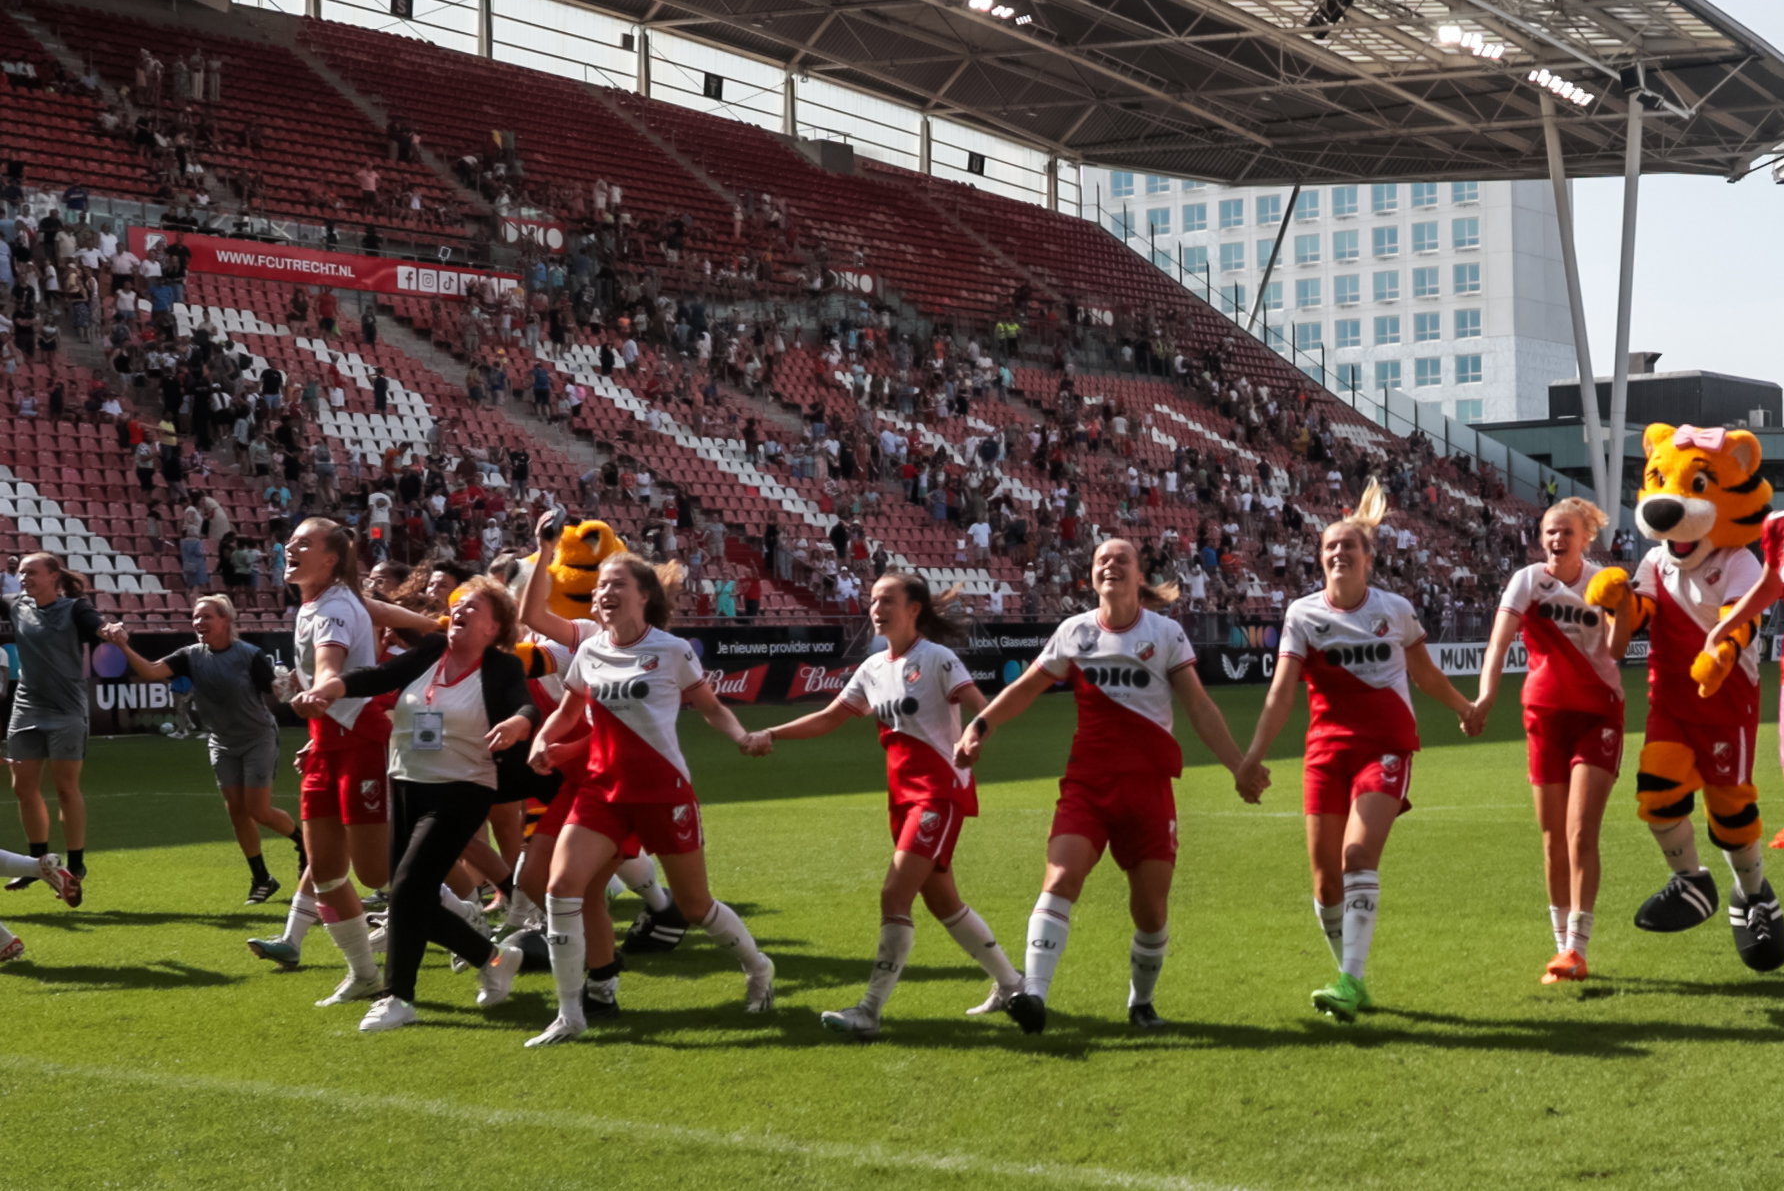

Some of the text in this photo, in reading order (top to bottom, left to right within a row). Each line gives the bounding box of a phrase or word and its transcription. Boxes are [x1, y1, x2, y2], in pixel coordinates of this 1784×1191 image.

[216, 249, 356, 278] WWW.FCUTRECHT.NL
[716, 640, 835, 657] Je nieuwe provider voor
[1000, 636, 1039, 648] Glasvezel
[1440, 647, 1528, 671] MUNTAD
